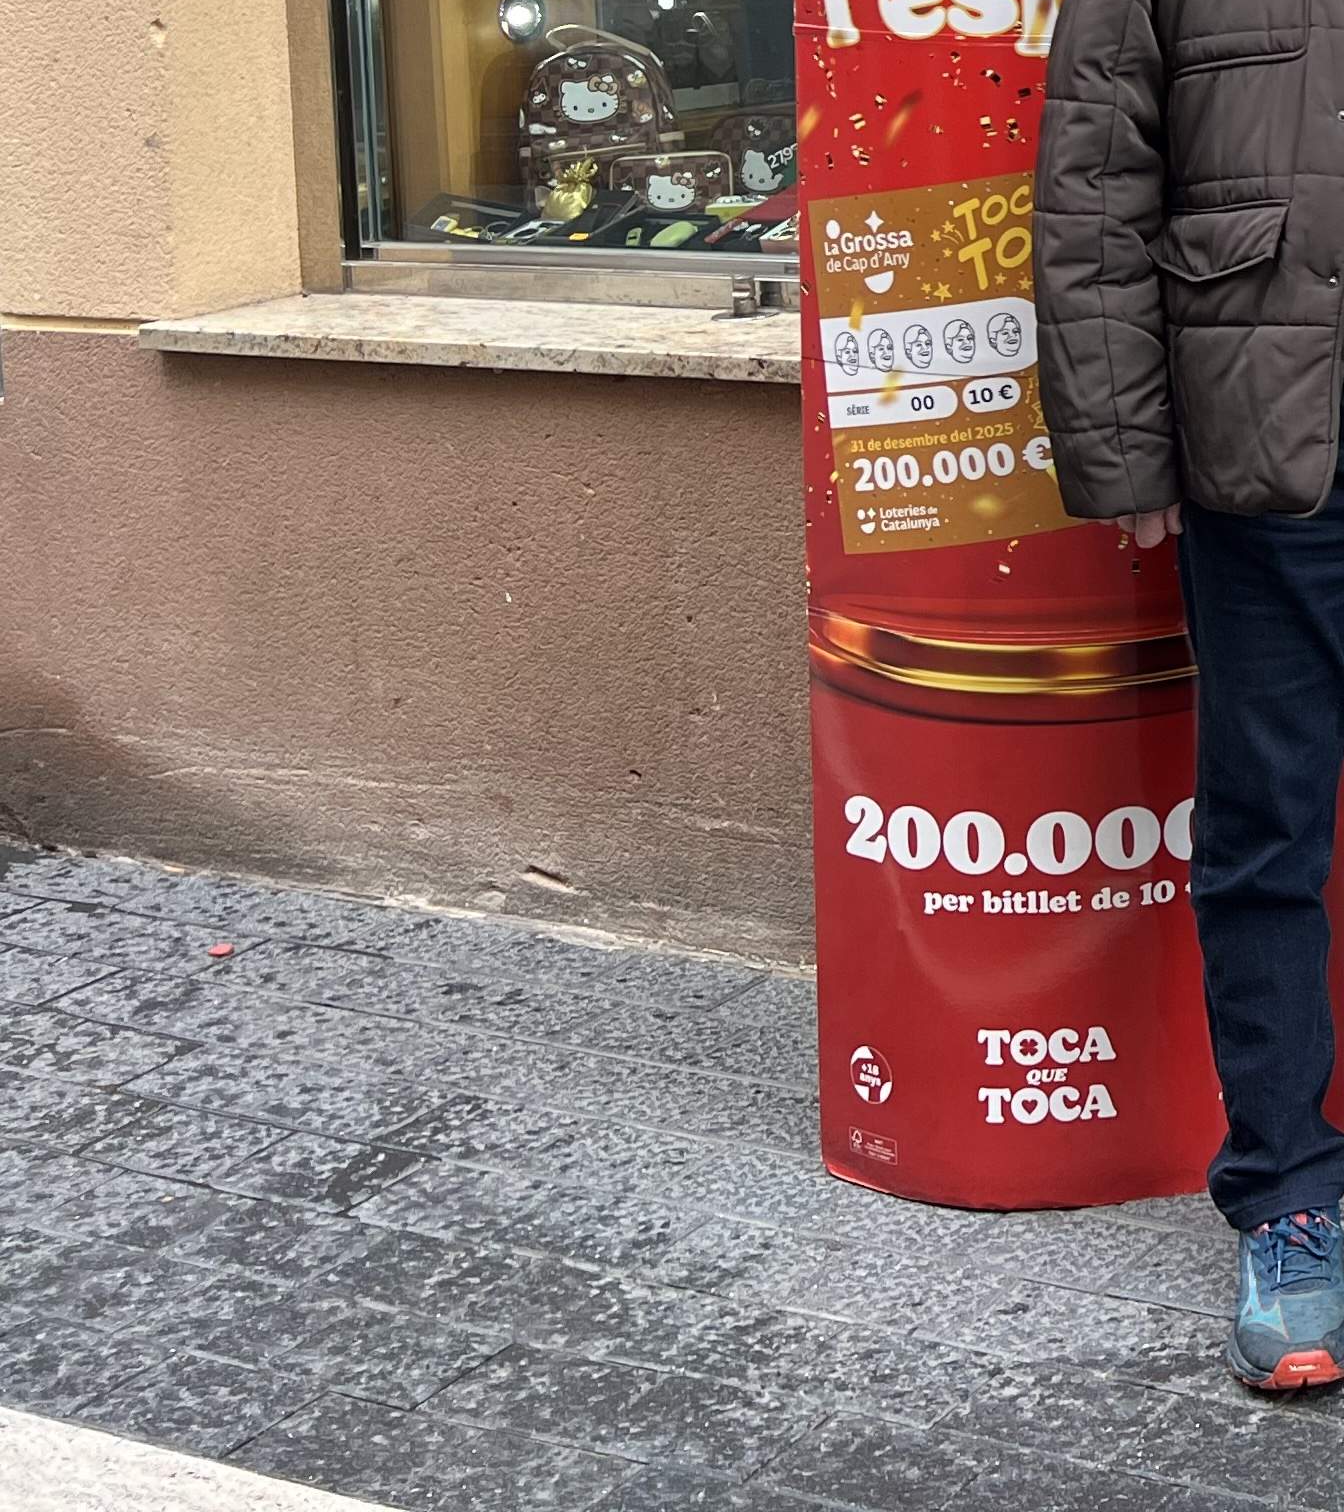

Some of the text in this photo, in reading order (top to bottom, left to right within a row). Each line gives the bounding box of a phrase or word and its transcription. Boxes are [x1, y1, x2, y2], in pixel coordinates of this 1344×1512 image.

[824, 230, 914, 256] La Grossa
[826, 258, 841, 273] de
[843, 256, 868, 273] Cap
[911, 395, 935, 412] 00
[968, 384, 1014, 405] 10 €
[867, 439, 882, 451] de
[883, 433, 948, 450] desembre
[950, 429, 973, 443] del
[975, 422, 1015, 439] 2025
[852, 436, 1054, 492] 200.000 €
[879, 506, 926, 519] Loteries
[881, 516, 940, 533] Catalunya
[923, 890, 974, 915] per
[983, 889, 1082, 914] bitllet
[1091, 886, 1131, 910] de
[1139, 880, 1176, 906] 10
[977, 1025, 1117, 1066] TOCA
[1026, 1068, 1068, 1083] QUE
[977, 1083, 1117, 1125] TOCA
